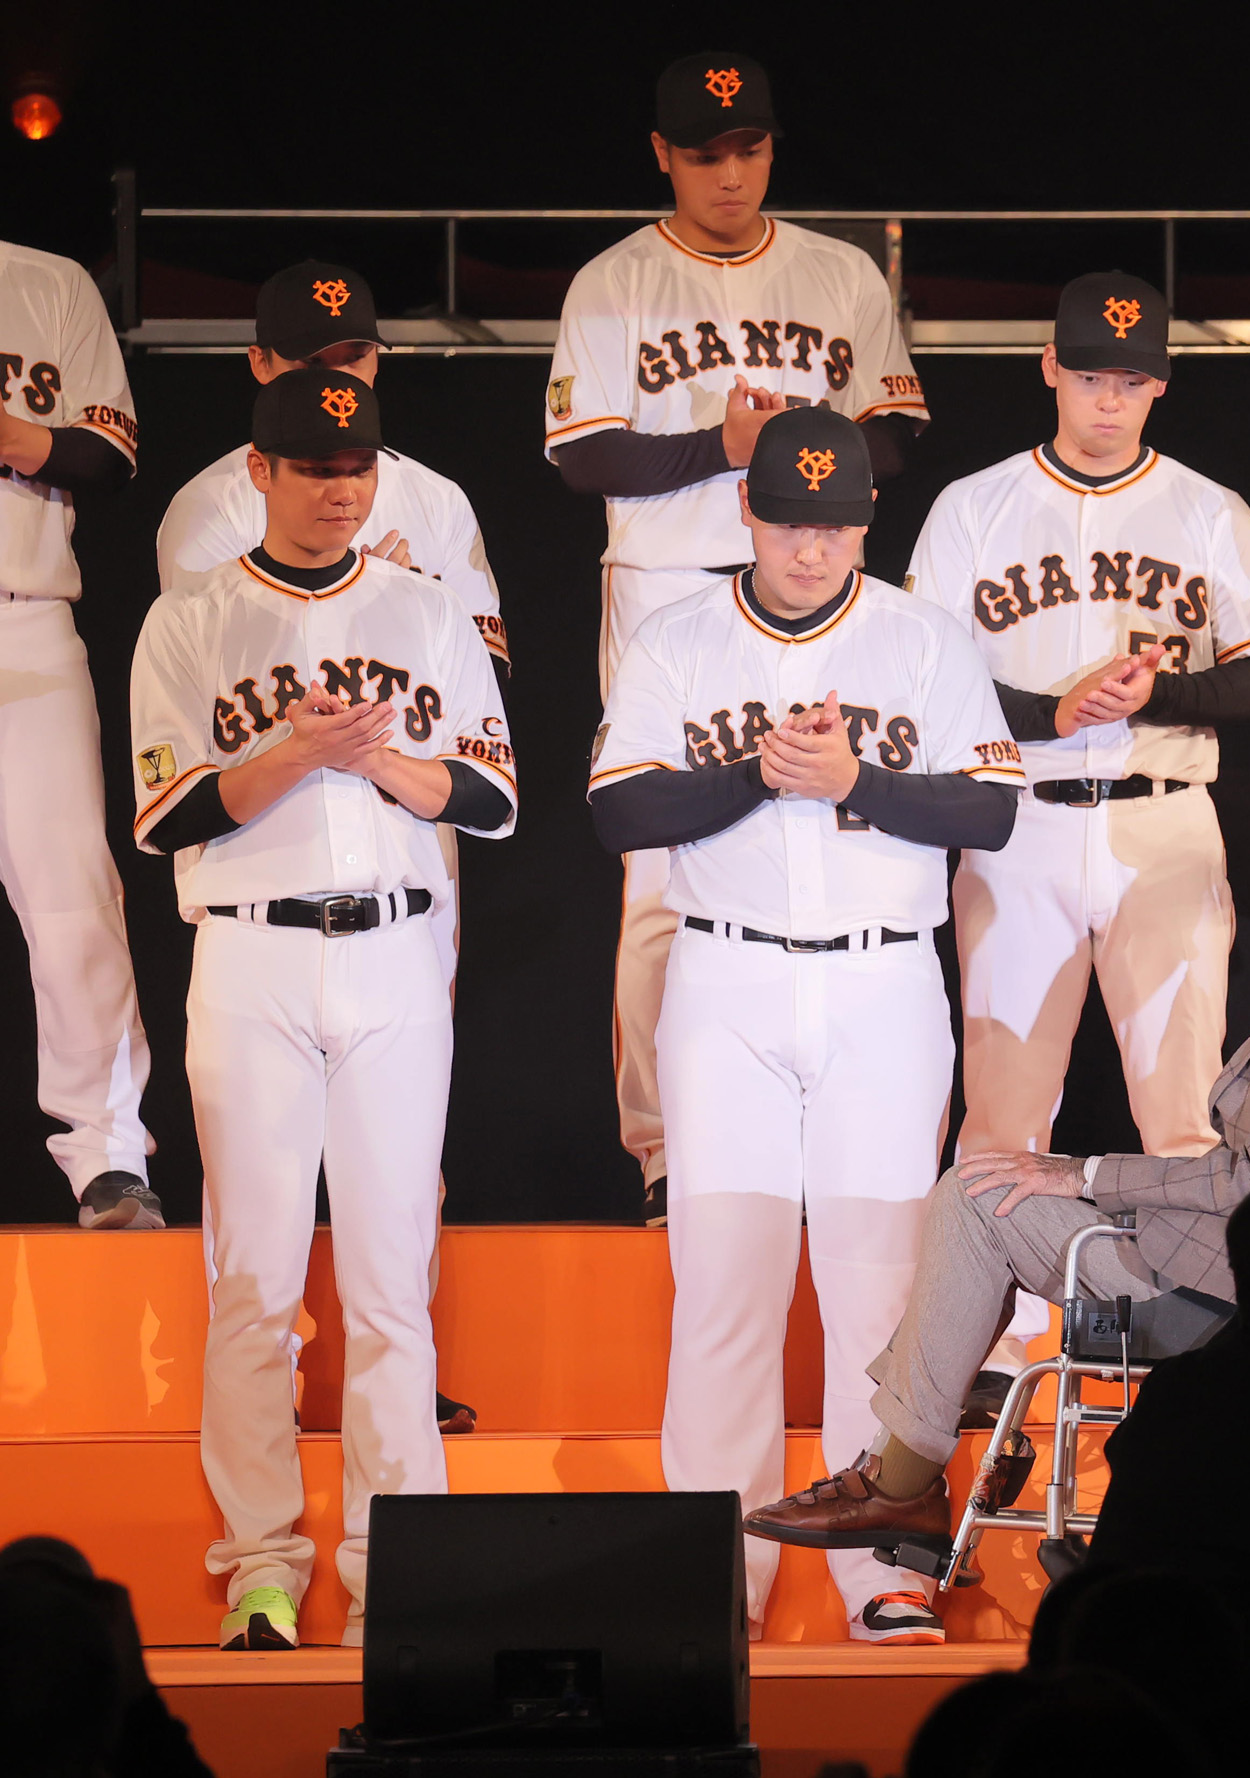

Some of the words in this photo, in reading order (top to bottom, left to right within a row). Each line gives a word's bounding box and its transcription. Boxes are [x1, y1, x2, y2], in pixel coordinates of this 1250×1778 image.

[638, 320, 854, 393] GIANTS
[974, 551, 1207, 633] GIANTS
[214, 656, 442, 754] GIANTS
